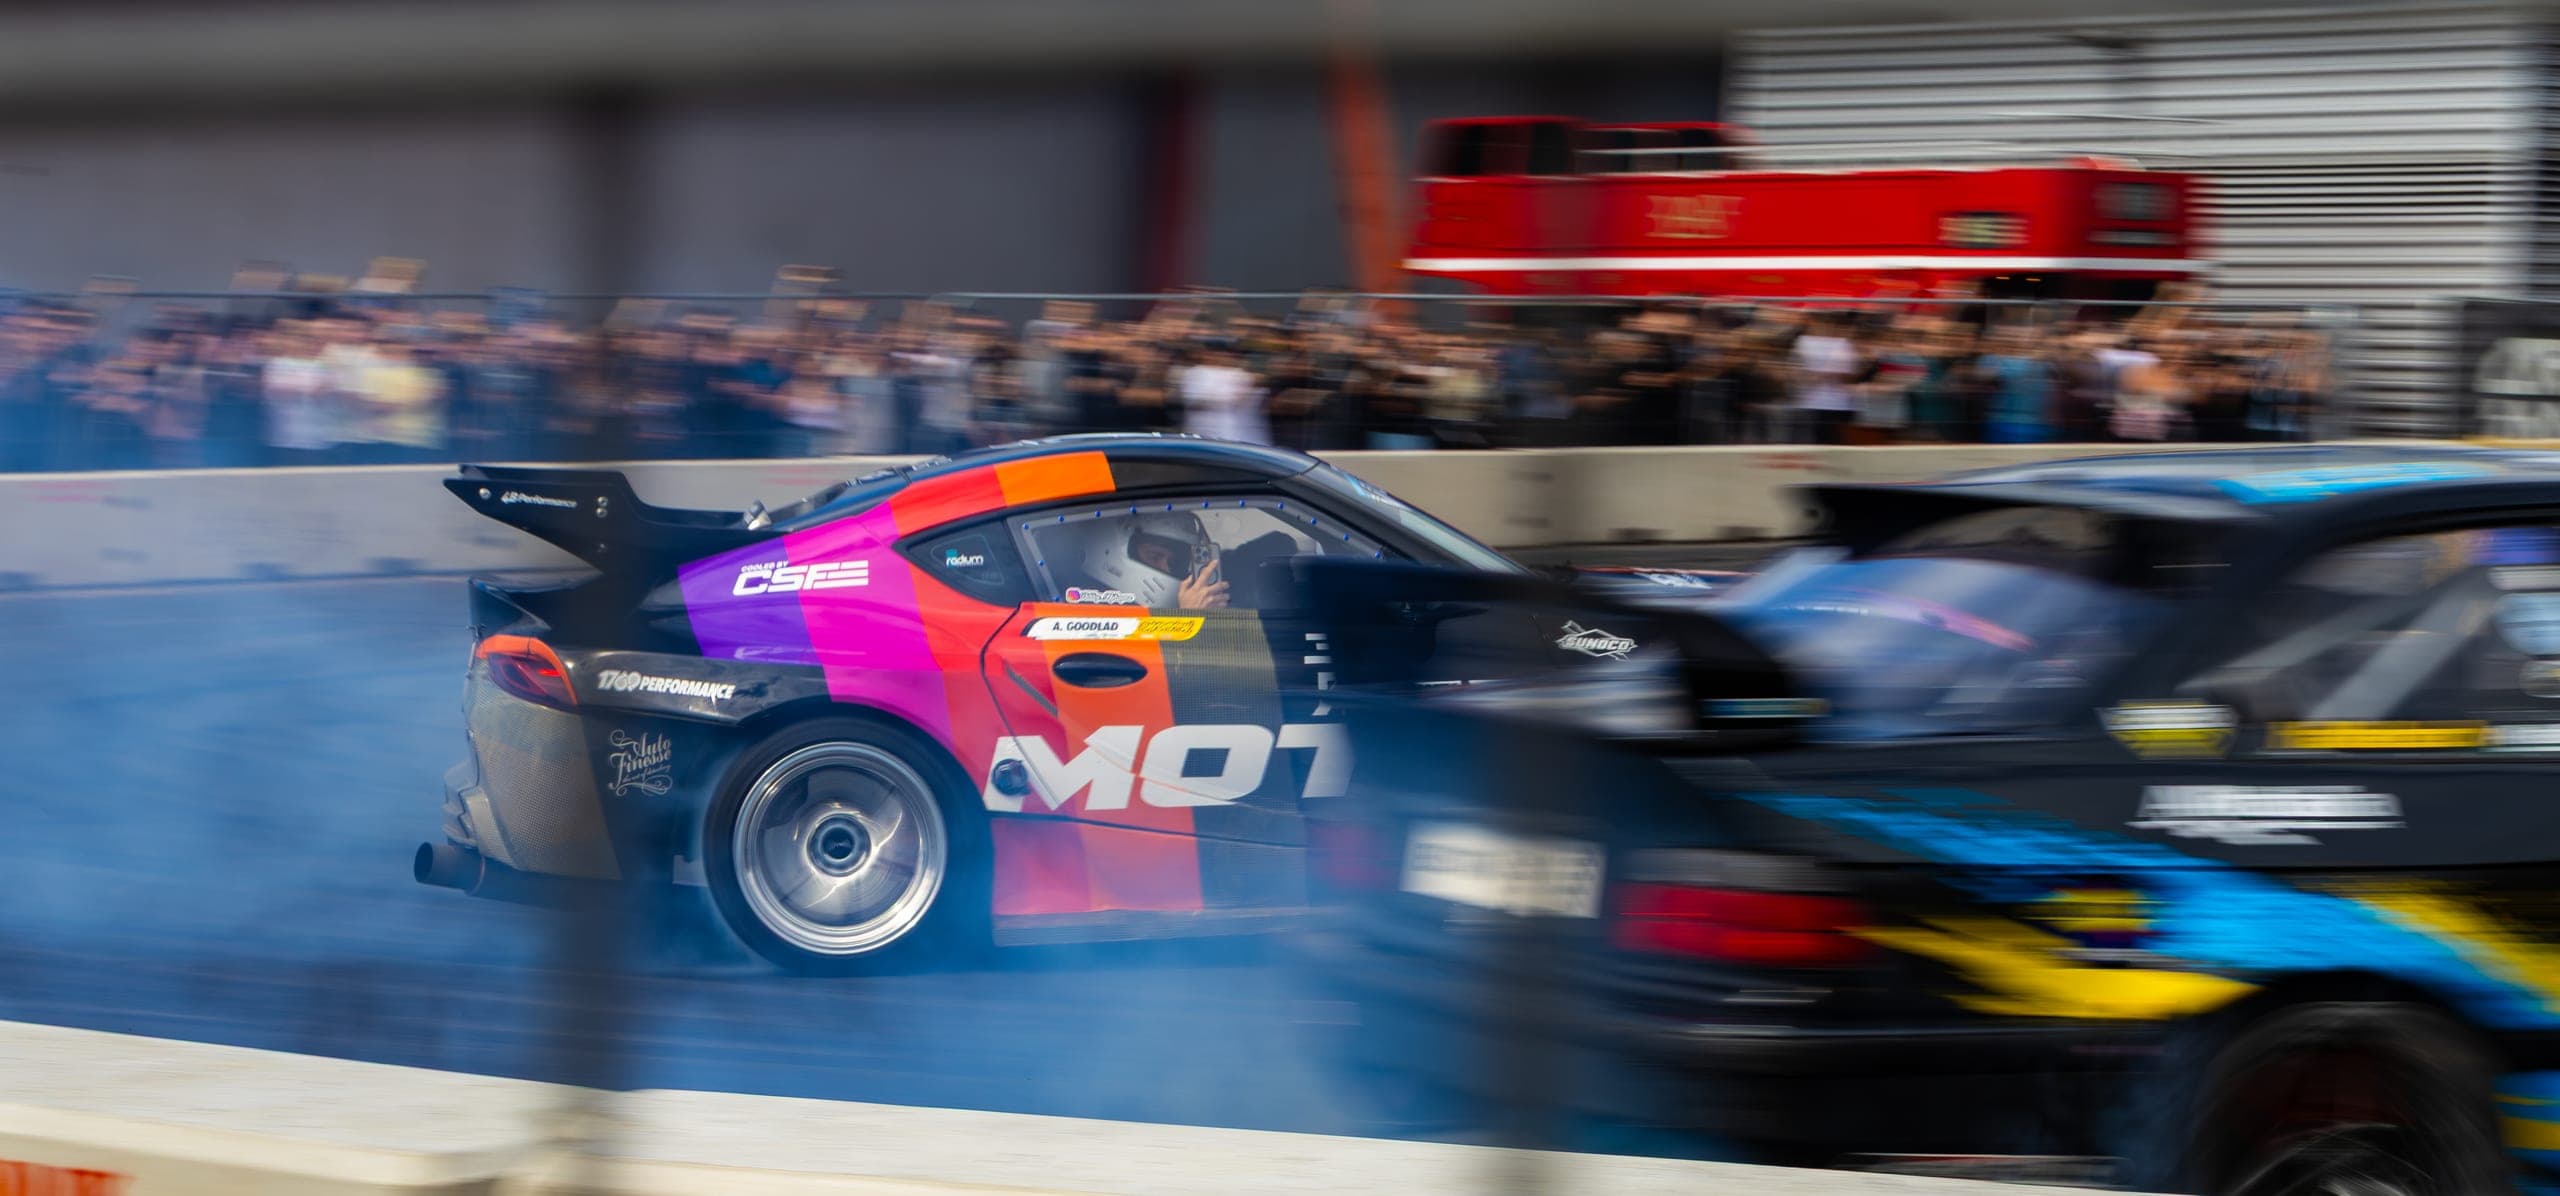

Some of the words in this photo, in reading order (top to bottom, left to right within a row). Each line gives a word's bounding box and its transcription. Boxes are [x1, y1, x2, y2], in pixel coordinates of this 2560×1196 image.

[946, 554, 984, 567] radium
[1052, 622, 1063, 631] A.
[1066, 622, 1118, 631] GOODLAD
[1567, 637, 1630, 650] SUNOCO
